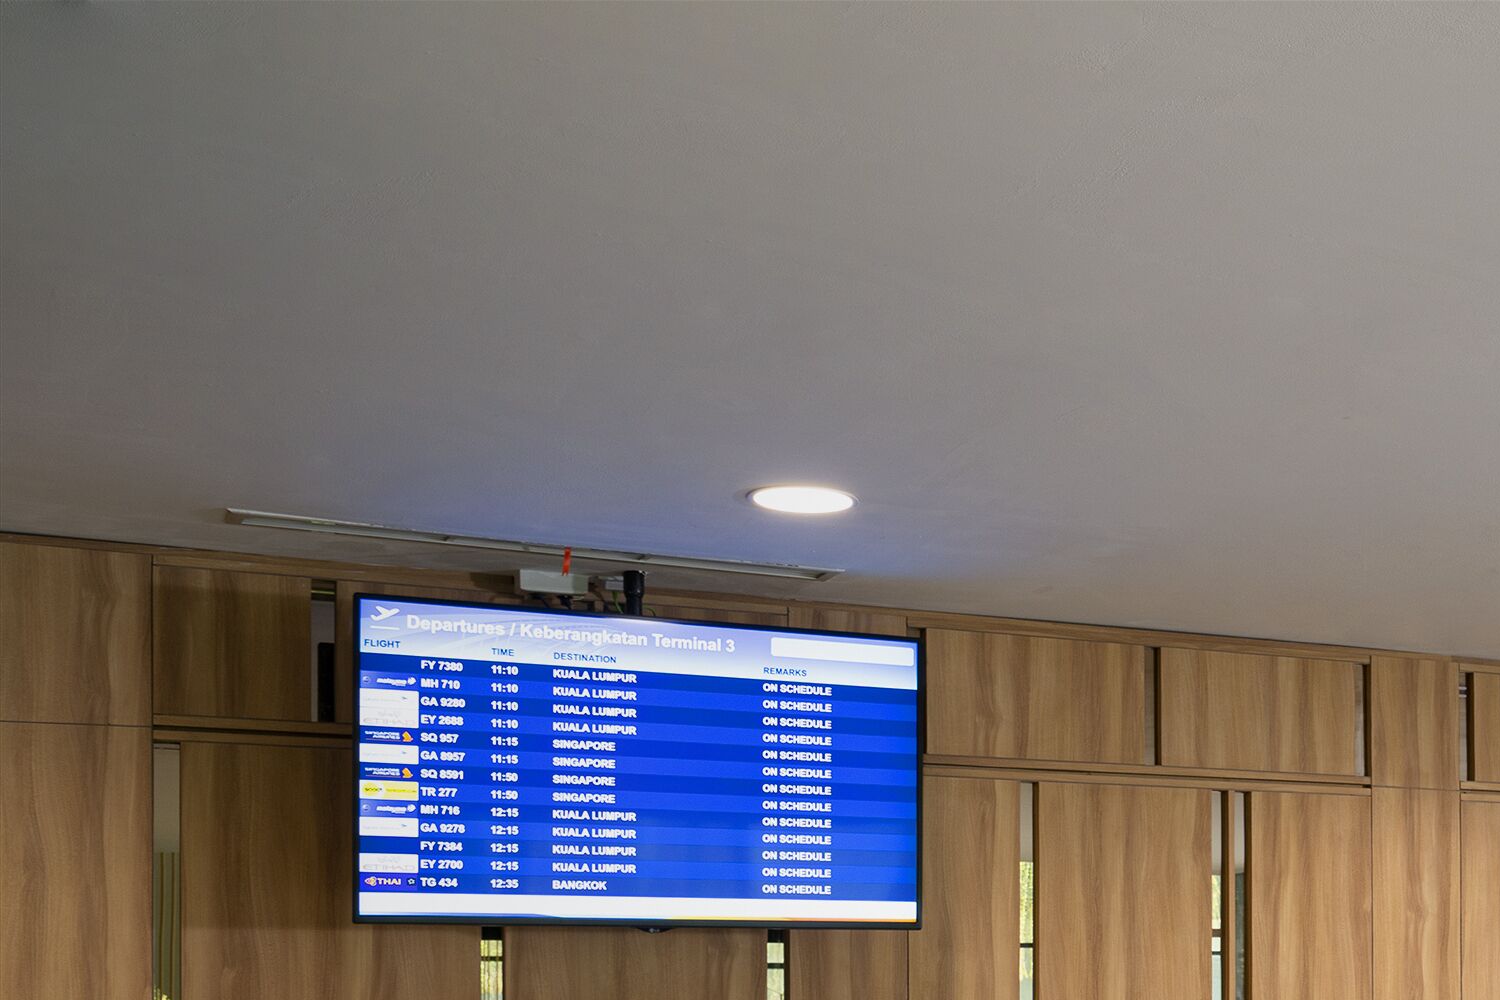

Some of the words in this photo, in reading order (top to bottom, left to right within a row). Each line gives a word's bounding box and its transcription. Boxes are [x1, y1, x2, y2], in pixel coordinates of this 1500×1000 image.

[406, 614, 505, 637] Departures
[509, 622, 516, 637] /
[520, 623, 647, 647] Keberangkatan
[652, 633, 722, 652] Terminal
[726, 638, 736, 653] 3
[364, 638, 401, 649] FLIGHT
[492, 647, 515, 657] TIME
[553, 652, 618, 664] DESTINATION
[420, 659, 437, 670] FY
[490, 664, 519, 676] 11:10
[552, 668, 590, 681] KUALA
[592, 671, 637, 684] LUMPUR
[763, 666, 808, 677] REMARKS
[420, 677, 439, 689] MH
[490, 682, 519, 694] 11:10
[552, 686, 590, 698] KUALA
[592, 688, 637, 701] LUMPUR
[762, 682, 777, 693] ON
[780, 683, 833, 697] SCHEDULE
[420, 696, 439, 707] GA
[490, 700, 519, 712] 11:10
[762, 699, 777, 710] ON
[780, 700, 833, 713] SCHEDULE
[552, 703, 590, 716] KUALA
[592, 706, 638, 718] LUMPUR
[420, 714, 437, 725] EY
[490, 718, 519, 729] 11:10
[762, 716, 777, 727] ON
[780, 717, 832, 730] SCHEDULE
[552, 721, 590, 733] KUALA
[592, 723, 637, 736] LUMPUR
[420, 732, 438, 743] SQ
[439, 733, 460, 744] 957
[490, 735, 519, 747] 11:15
[762, 733, 777, 743] ON
[780, 734, 833, 746] SCHEDULE
[552, 738, 616, 752] SINGAPORE
[420, 750, 439, 761] GA
[490, 753, 519, 765] 11:15
[762, 749, 777, 760] ON
[780, 750, 832, 763] SCHEDULE
[552, 756, 616, 769] SINGAPORE
[420, 768, 438, 779] SQ
[490, 771, 519, 782] 11:50
[762, 766, 777, 777] ON
[780, 767, 833, 779] SCHEDULE
[552, 774, 616, 787] SINGAPORE
[419, 786, 437, 797] TR
[438, 787, 458, 798] 277
[490, 789, 519, 800] 11:50
[762, 783, 777, 794] ON
[779, 784, 832, 796] SCHEDULE
[552, 791, 616, 804] SINGAPORE
[420, 804, 439, 815] MH
[490, 807, 519, 818] 12:15
[762, 800, 777, 810] ON
[780, 800, 832, 813] SCHEDULE
[552, 809, 590, 820] KUALA
[592, 810, 637, 822] LUMPUR
[419, 822, 439, 833] GA
[761, 816, 777, 827] ON
[779, 817, 832, 829] SCHEDULE
[490, 825, 519, 836] 12:15
[552, 826, 590, 838] KUALA
[592, 828, 637, 839] LUMPUR
[420, 840, 436, 851] FY
[761, 833, 777, 844] ON
[779, 834, 832, 846] SCHEDULE
[490, 842, 519, 853] 12:15
[551, 844, 590, 856] KUALA
[592, 845, 637, 857] LUMPUR
[761, 850, 777, 861] ON
[779, 850, 832, 862] SCHEDULE
[419, 858, 437, 869] EY
[490, 860, 519, 871] 12:15
[552, 862, 590, 873] KUALA
[592, 863, 637, 874] LUMPUR
[761, 867, 777, 877] ON
[779, 867, 832, 879] SCHEDULE
[377, 878, 402, 886] THAI
[419, 877, 437, 887] TG
[438, 877, 459, 888] 434
[490, 878, 519, 889] 12:35
[551, 879, 608, 891] BANGKOK
[761, 884, 777, 894] ON
[779, 884, 832, 895] SCHEDULE
